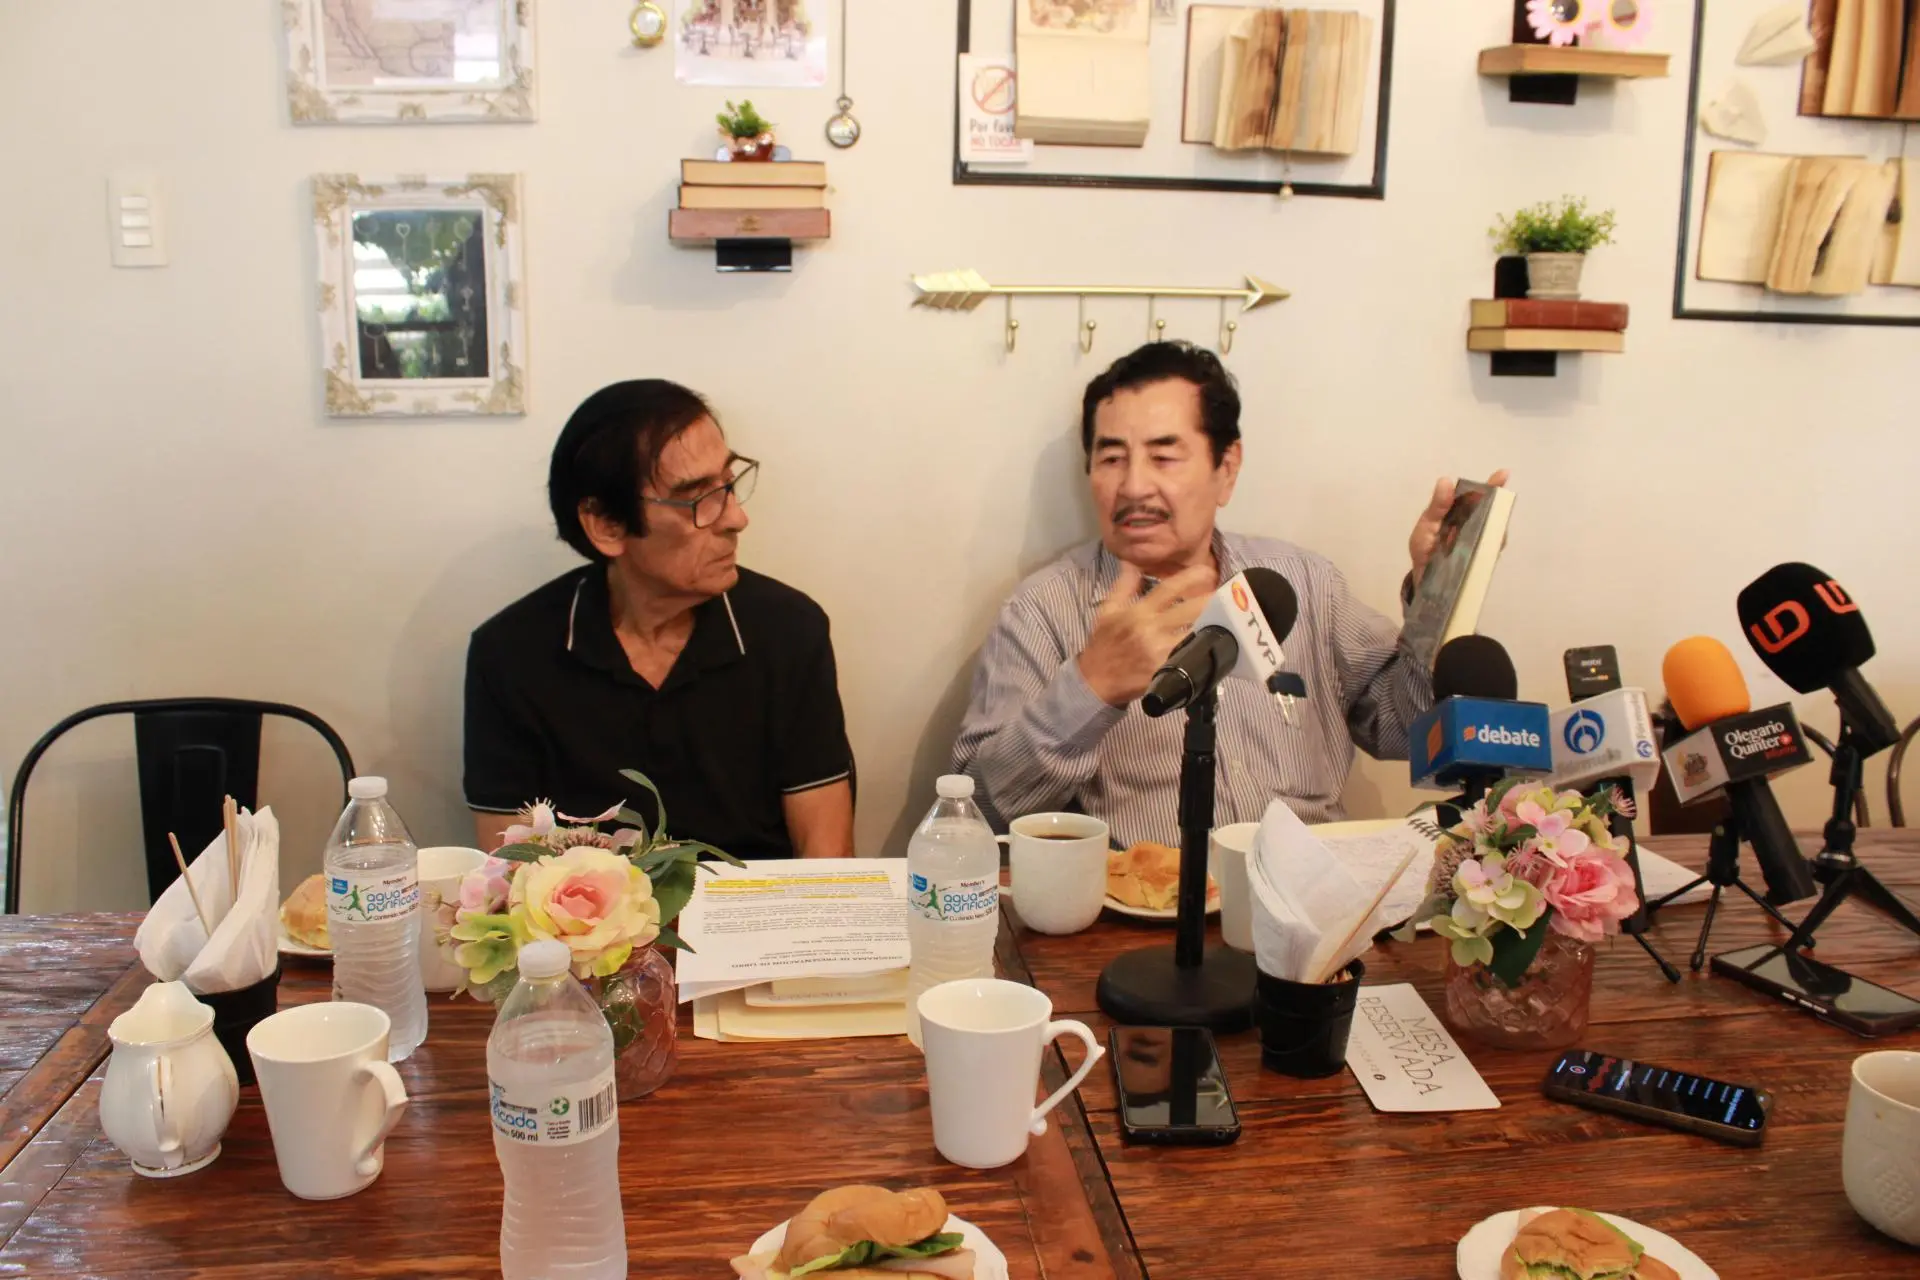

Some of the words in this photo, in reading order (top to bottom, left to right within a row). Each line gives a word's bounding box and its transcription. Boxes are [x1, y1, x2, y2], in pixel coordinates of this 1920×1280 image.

[969, 118, 988, 132] Por
[993, 118, 1015, 132] fav
[1247, 611, 1276, 666] TVP
[1478, 724, 1540, 748] debate
[1724, 720, 1785, 746] Olegario
[366, 889, 401, 906] agua
[943, 893, 977, 906] agua
[1357, 996, 1443, 1096] RESERVADA
[1400, 1016, 1456, 1067] MESA
